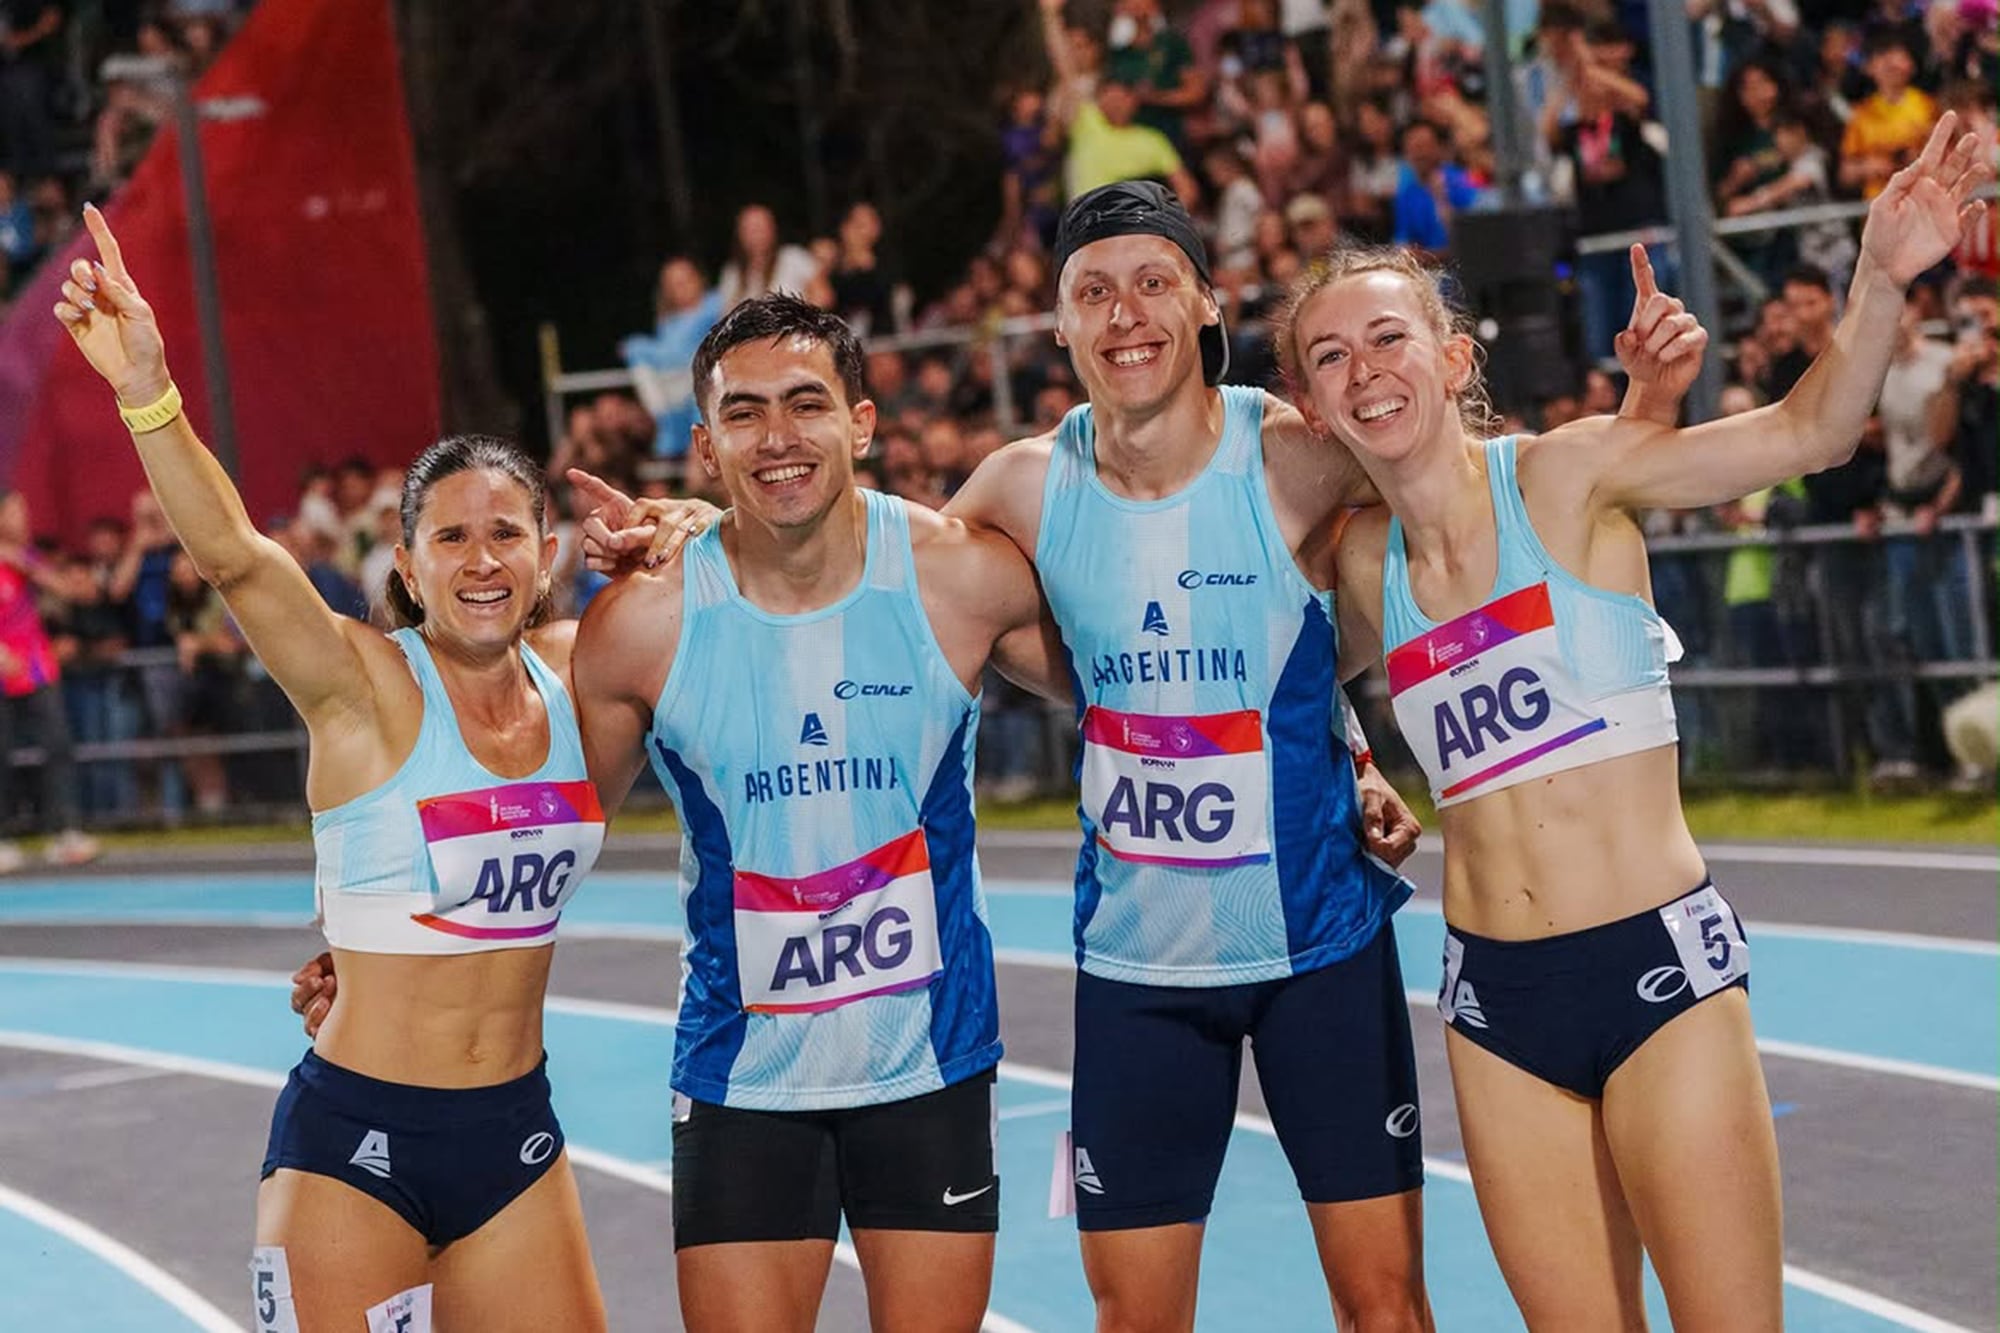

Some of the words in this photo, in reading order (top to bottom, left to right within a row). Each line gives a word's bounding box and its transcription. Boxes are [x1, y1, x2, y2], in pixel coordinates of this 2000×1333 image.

[1092, 648, 1246, 687] ARGENTINA
[1434, 667, 1550, 771] ARG
[1102, 776, 1235, 843] ARG
[456, 849, 576, 913] ARG
[769, 906, 912, 991] ARG
[1699, 913, 1731, 970] 5
[257, 1272, 276, 1323] 5
